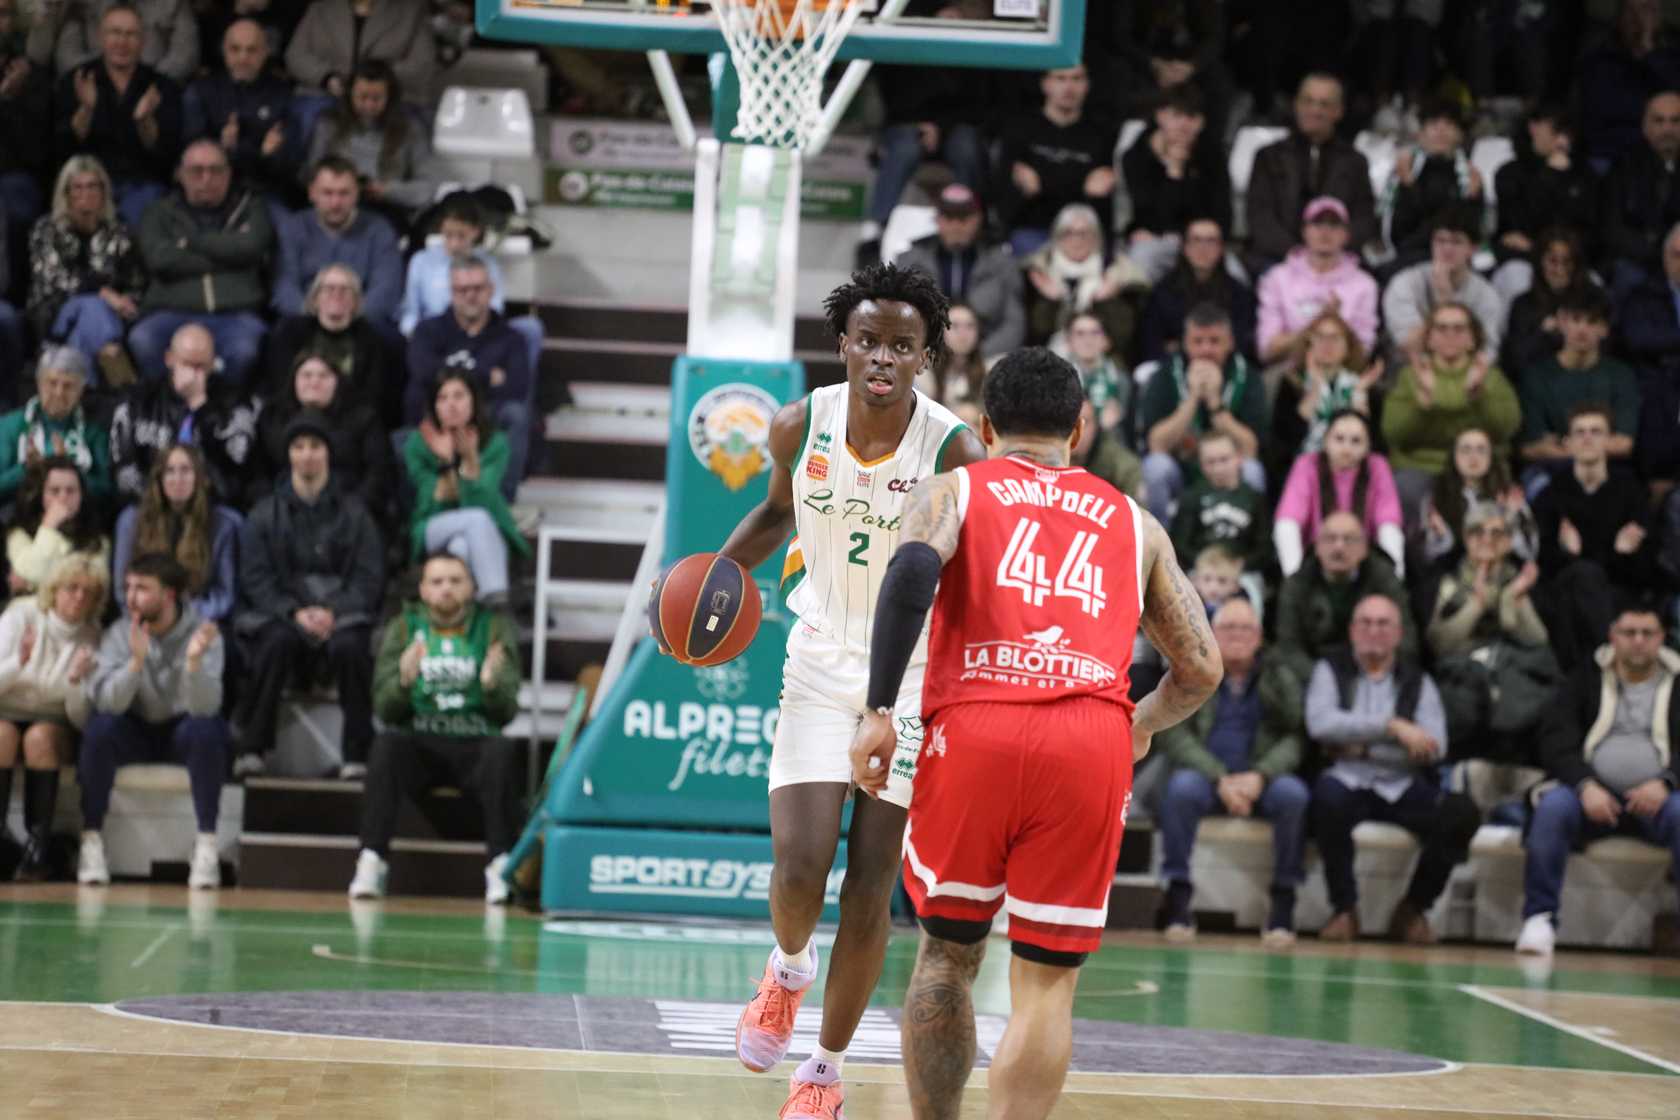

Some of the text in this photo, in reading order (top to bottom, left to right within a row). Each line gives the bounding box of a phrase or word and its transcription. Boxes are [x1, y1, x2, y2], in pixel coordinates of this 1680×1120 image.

[807, 466, 827, 477] KING
[803, 488, 902, 531] Le Port
[848, 531, 870, 566] 2
[996, 517, 1108, 618] 44
[964, 647, 990, 669] LA
